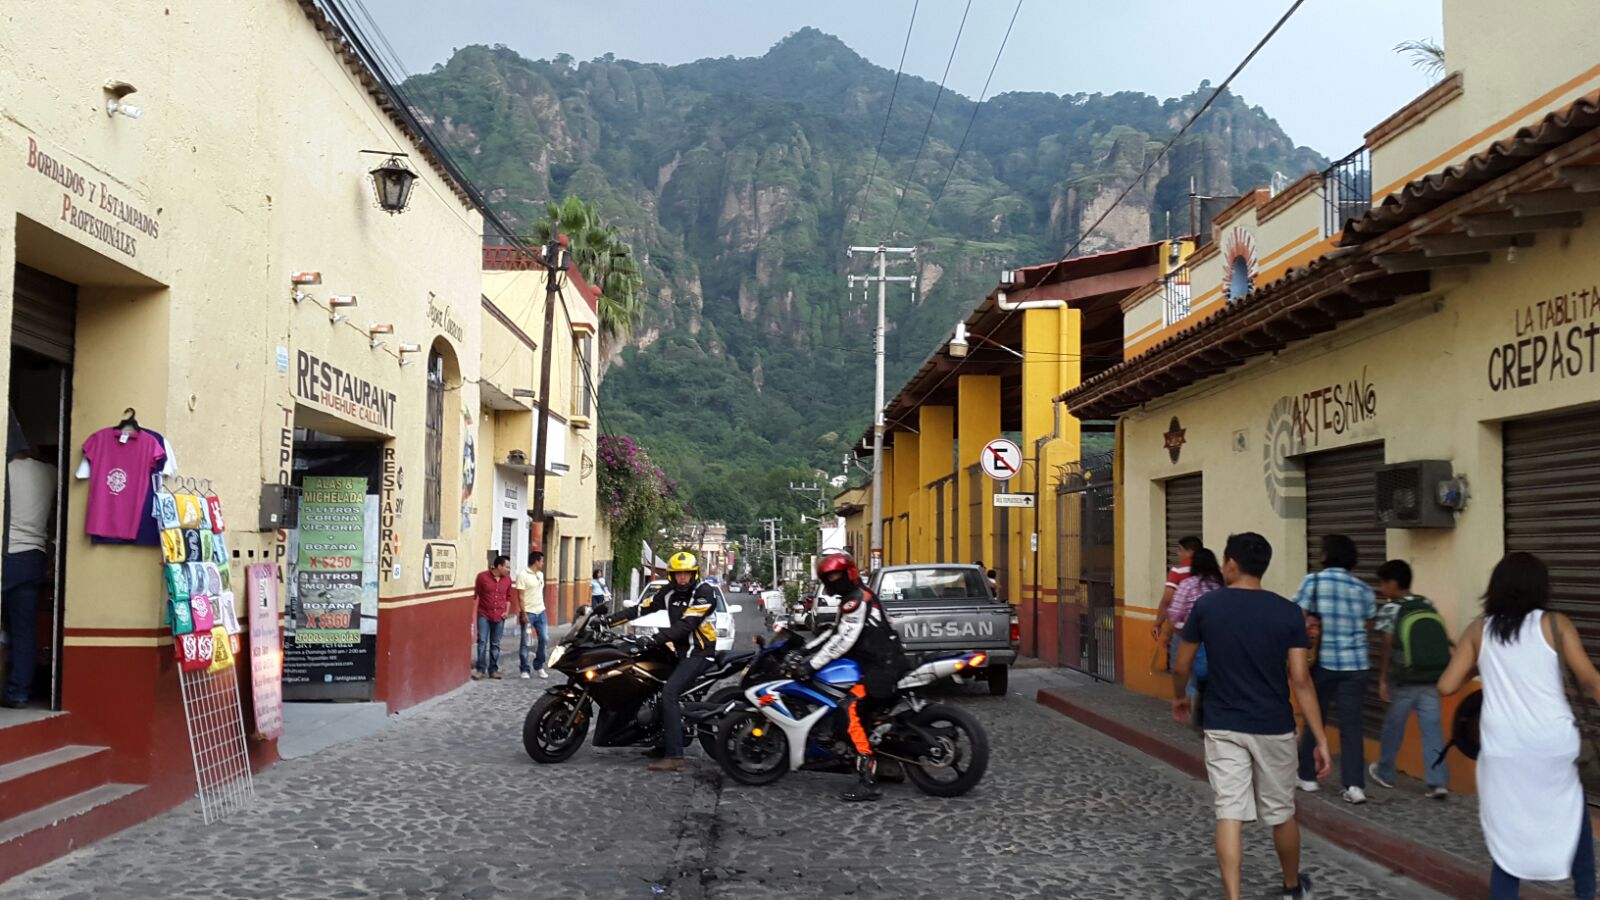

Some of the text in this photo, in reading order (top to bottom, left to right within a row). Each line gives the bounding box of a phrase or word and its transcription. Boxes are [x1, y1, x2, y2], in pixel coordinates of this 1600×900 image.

[27, 136, 160, 240] BORDADOS Y ESTAMPADOS
[60, 194, 137, 258] PROFESIONALES
[1515, 305, 1534, 338] LA
[297, 349, 397, 430] RESTAURANT
[320, 391, 357, 417] HUEHUE
[1290, 365, 1377, 447] ARTESANO
[993, 448, 1009, 471] E
[315, 480, 354, 490] ALAS &
[276, 408, 292, 584] TEPO SPA
[304, 491, 364, 504] MICHELADA
[305, 514, 359, 522] CORONA
[316, 506, 360, 514] LITROS
[381, 448, 396, 583] RESTAURANT
[305, 544, 357, 552] BOTANA
[322, 556, 353, 570] $250
[312, 573, 359, 581] LITROS
[304, 583, 354, 591] MOJITO
[319, 613, 351, 629] $360
[904, 621, 994, 638] NISSAN
